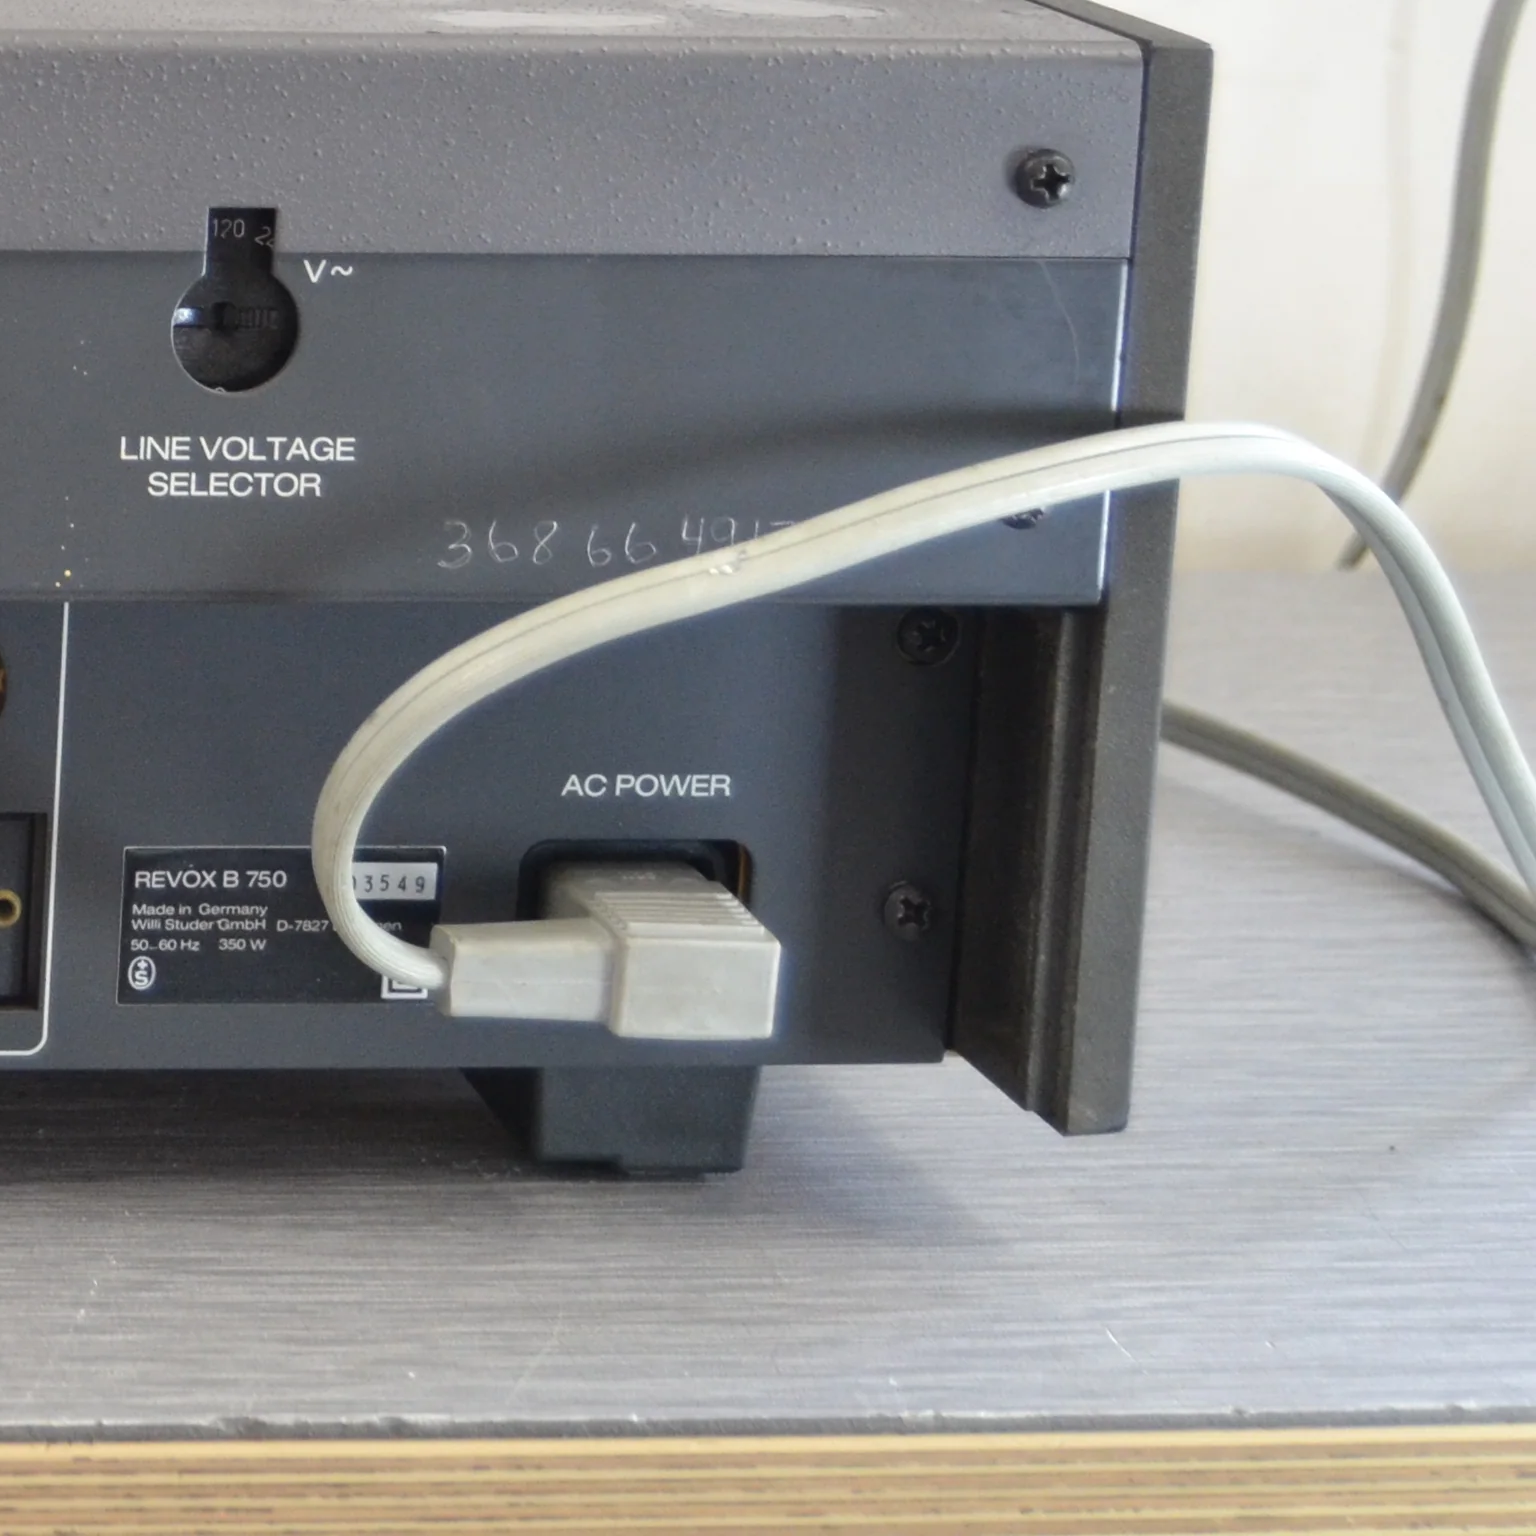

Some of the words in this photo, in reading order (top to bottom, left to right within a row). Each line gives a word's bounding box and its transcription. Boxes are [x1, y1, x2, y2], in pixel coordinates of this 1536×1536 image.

[121, 436, 191, 460] LINE
[200, 436, 355, 461] VOLTAGE
[148, 472, 321, 497] SELECTOR
[562, 774, 607, 797] AC
[615, 774, 731, 797] POWER
[135, 870, 216, 888] REVOX
[223, 870, 239, 888] B
[246, 870, 287, 888] 750
[132, 904, 175, 915] Made
[179, 904, 192, 915] in
[199, 903, 268, 917] Germany
[131, 918, 161, 930] Willi
[165, 919, 214, 930] Studer
[216, 918, 266, 931] GmbH
[180, 940, 200, 951] Hz
[219, 938, 246, 950] 350
[250, 939, 266, 950] W
